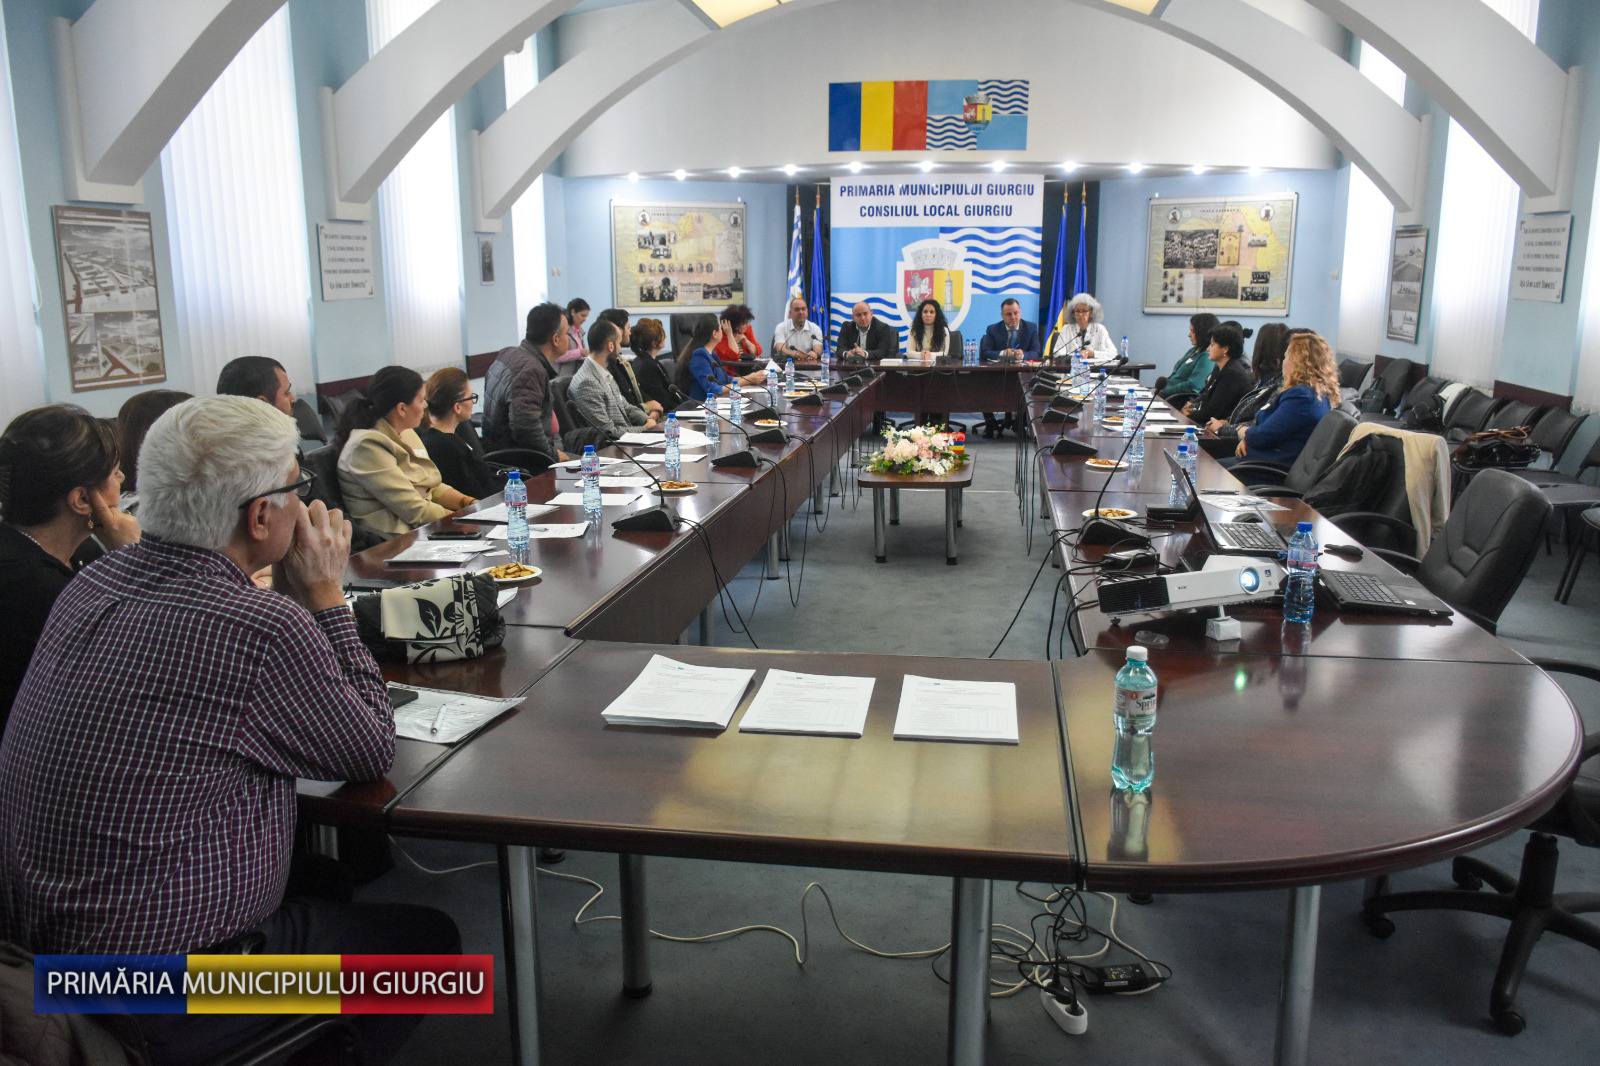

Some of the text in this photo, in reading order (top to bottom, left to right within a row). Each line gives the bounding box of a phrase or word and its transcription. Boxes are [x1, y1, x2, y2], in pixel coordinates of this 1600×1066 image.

[840, 183, 1035, 197] PRIMARIA MUNICIPIULUI GIURGIU
[860, 204, 1013, 217] CONSILIUL LOCAL GIURGIU
